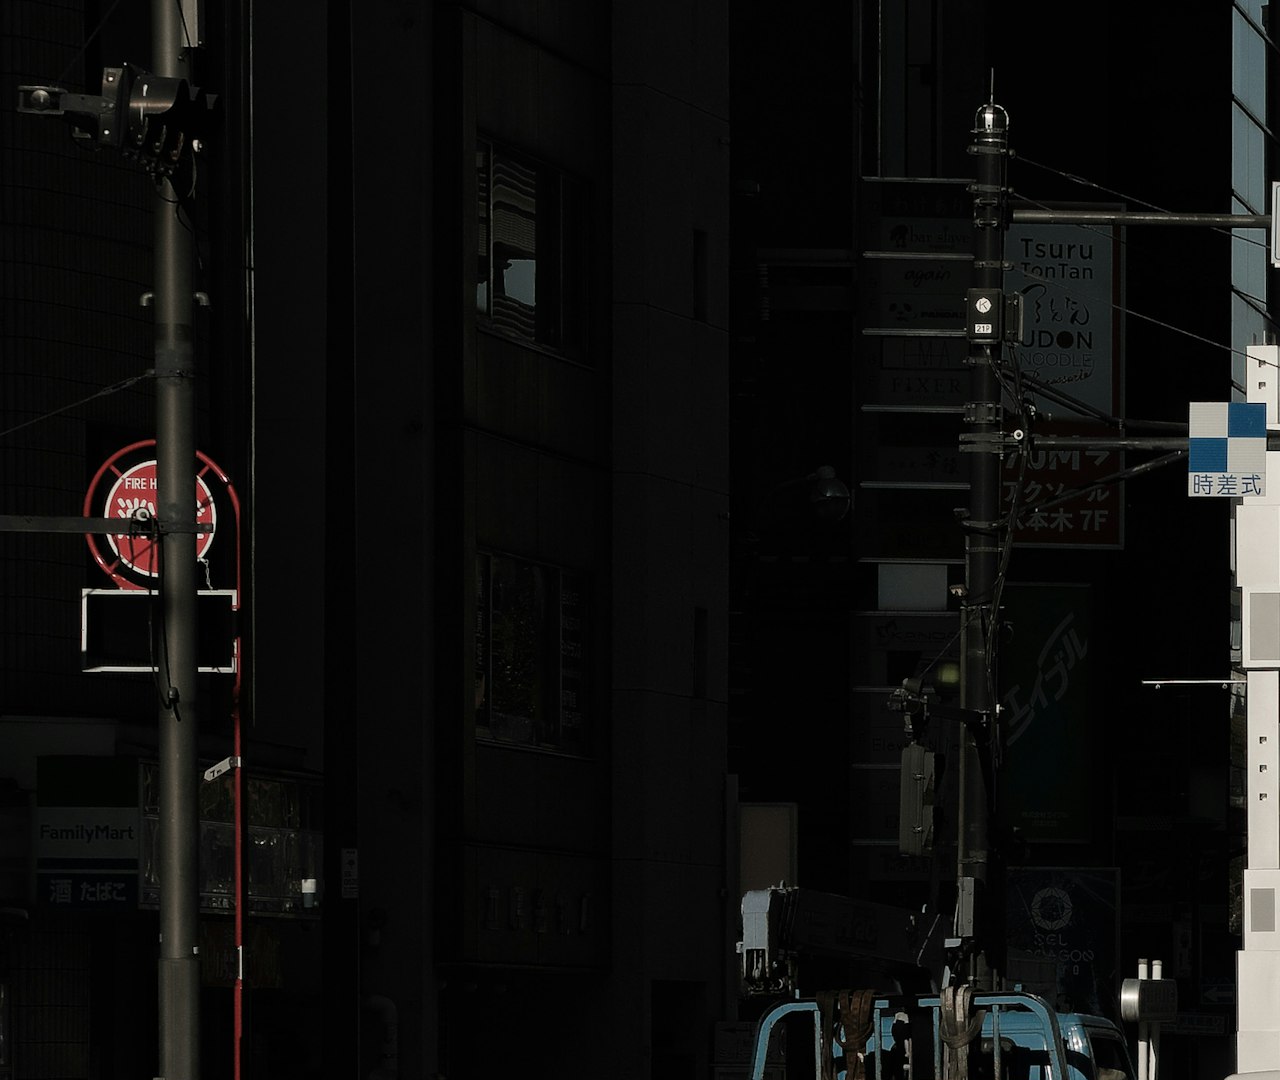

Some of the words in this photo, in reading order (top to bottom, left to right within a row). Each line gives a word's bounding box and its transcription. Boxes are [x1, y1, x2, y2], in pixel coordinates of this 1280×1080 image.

[1020, 238, 1093, 260] Tsuru
[1021, 262, 1093, 280] TonTan
[1020, 352, 1093, 368] NOODLE
[124, 477, 148, 490] FIRE
[1192, 474, 1262, 495] 時差式
[1079, 509, 1110, 531] 7F
[40, 824, 135, 844] FamilyMart
[49, 879, 73, 904] 酒
[79, 881, 127, 902] たばこ
